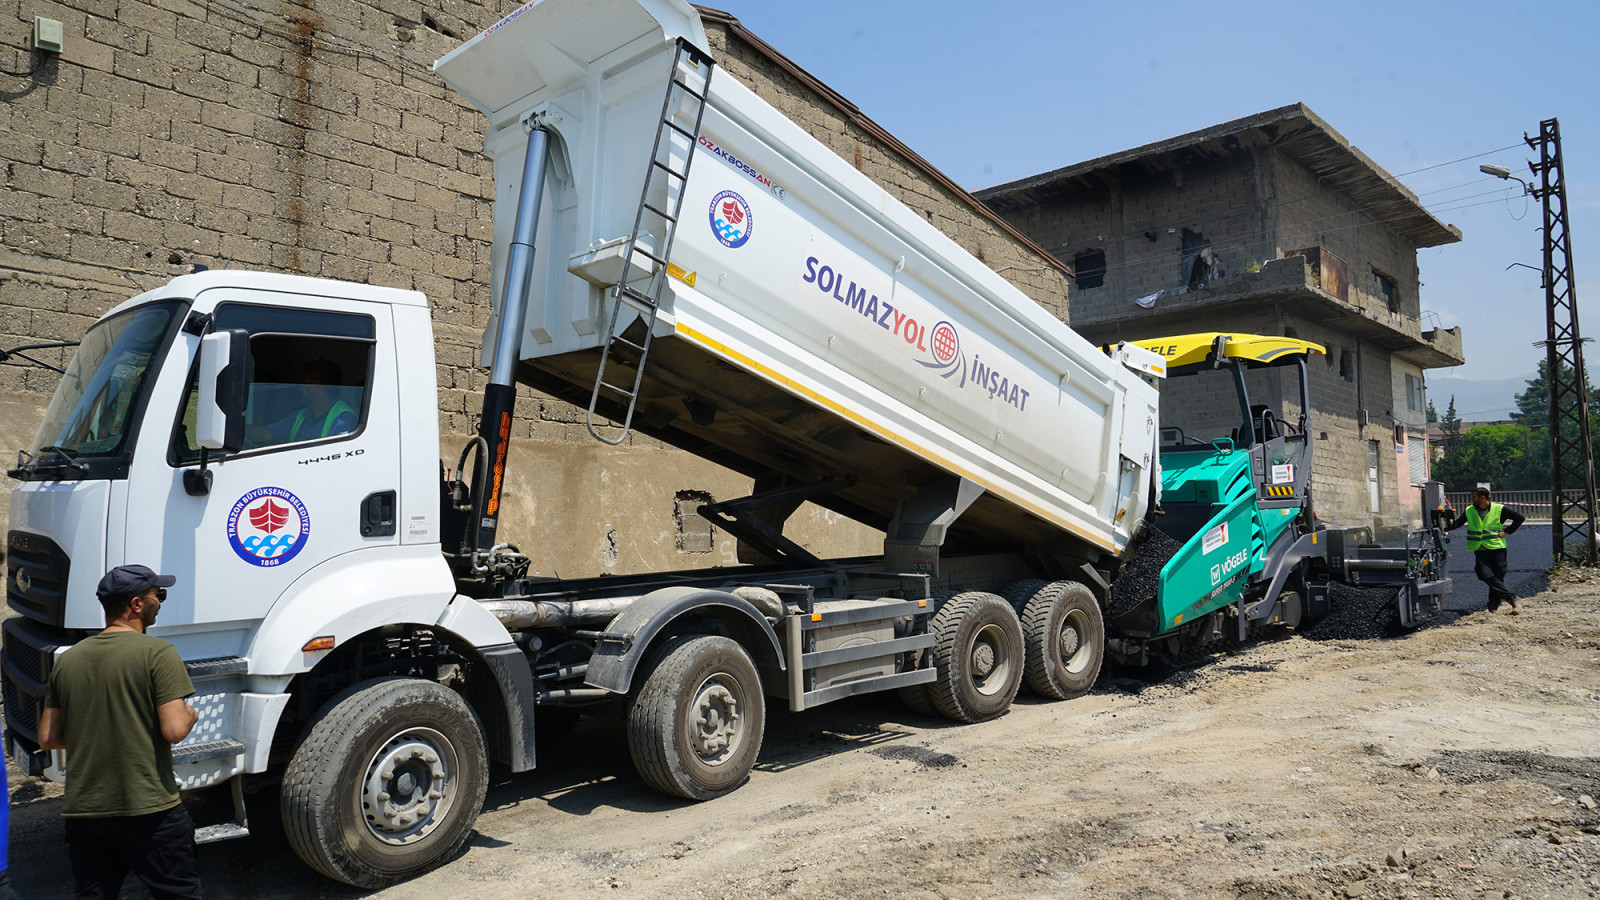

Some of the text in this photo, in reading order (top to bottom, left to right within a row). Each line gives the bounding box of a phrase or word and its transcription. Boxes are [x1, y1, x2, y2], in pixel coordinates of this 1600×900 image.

[698, 135, 771, 188] ÖZAKBOSSAN
[802, 256, 927, 353] SOLMAZYOL
[970, 354, 1030, 412] İNŞAAT
[345, 449, 365, 458] XD
[228, 487, 310, 539] TRABZON BÜYÜKŞEHİR BELEDİYESİ
[260, 558, 280, 567] 1868
[1221, 548, 1248, 575] VÖGELE
